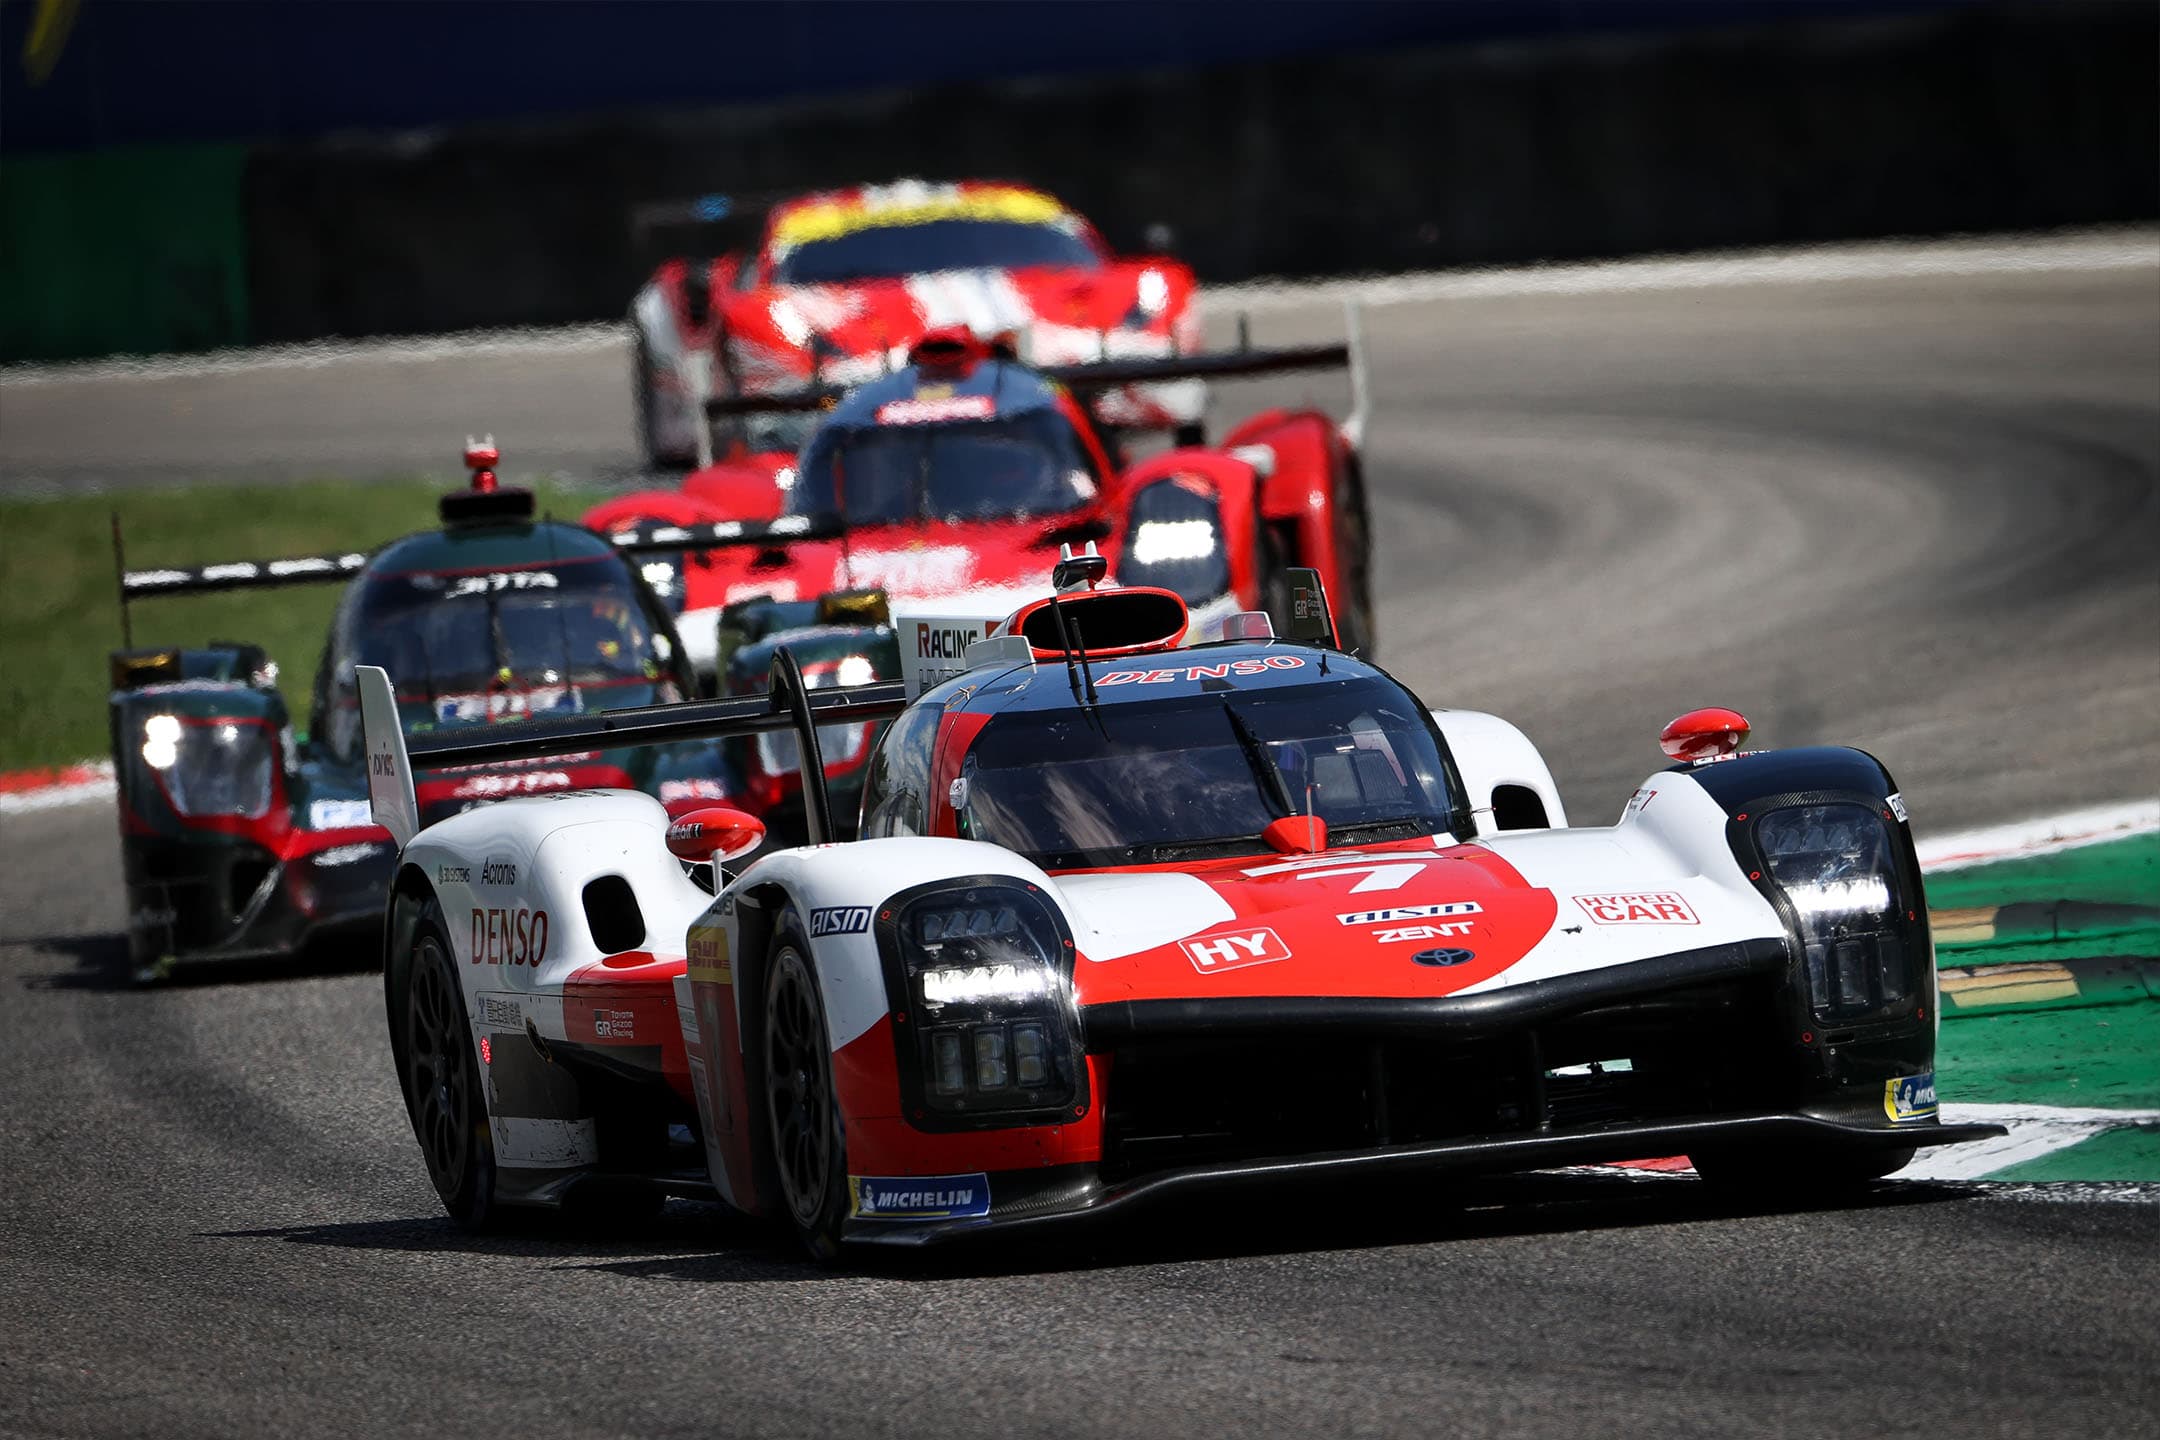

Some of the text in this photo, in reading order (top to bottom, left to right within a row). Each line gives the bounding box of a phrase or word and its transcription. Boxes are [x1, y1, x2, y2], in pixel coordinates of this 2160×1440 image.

[1093, 655, 1305, 687] DENSO
[1640, 790, 1658, 811] 7
[481, 857, 516, 886] Acronis
[1296, 863, 1428, 894] 7
[1582, 894, 1677, 906] HYPER
[1593, 903, 1689, 920] CAR
[812, 908, 869, 935] AISIN
[1346, 903, 1475, 924] AISIN
[471, 908, 549, 968] DENSO
[1372, 921, 1475, 944] ZENT
[1189, 932, 1268, 966] HY
[595, 1021, 612, 1036] GR
[877, 1189, 973, 1208] MICHELIN
